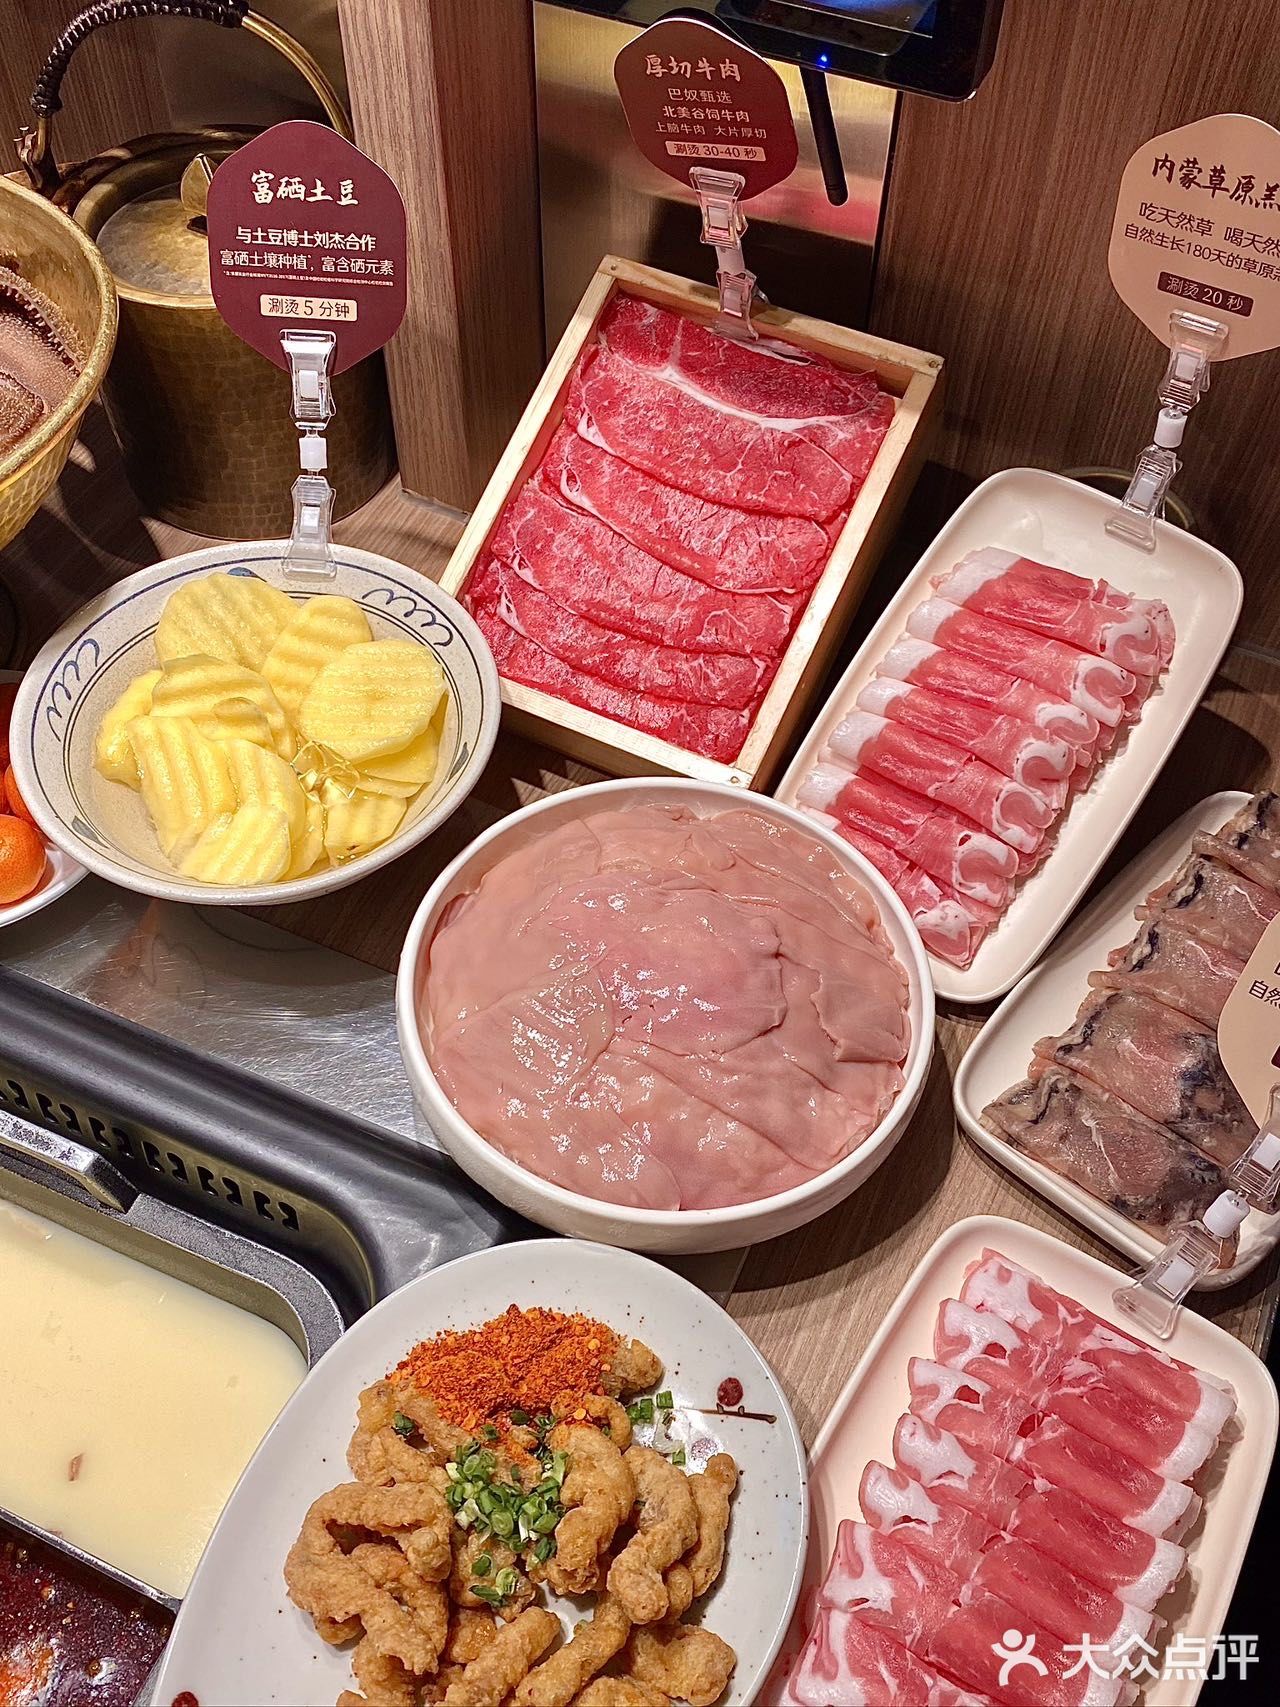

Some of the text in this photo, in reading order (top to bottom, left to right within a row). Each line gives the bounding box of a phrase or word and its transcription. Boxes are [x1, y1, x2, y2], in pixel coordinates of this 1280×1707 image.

[644, 54, 741, 82] 厚切牛肉
[667, 87, 733, 104] 巴奴甄选
[662, 105, 750, 122] 北美谷饲牛肉
[655, 121, 767, 139] 上脑牛肉 大片厚切
[673, 142, 757, 159] 涮烫 30-40 秒
[251, 169, 359, 206] 富硒土豆
[235, 225, 377, 252] 与土豆博士刘杰合作
[1138, 202, 1280, 259] 吃天然草 喝天然
[1166, 276, 1244, 311] 涮烫 20 秒
[267, 297, 350, 318] 涮烫 5 分钟
